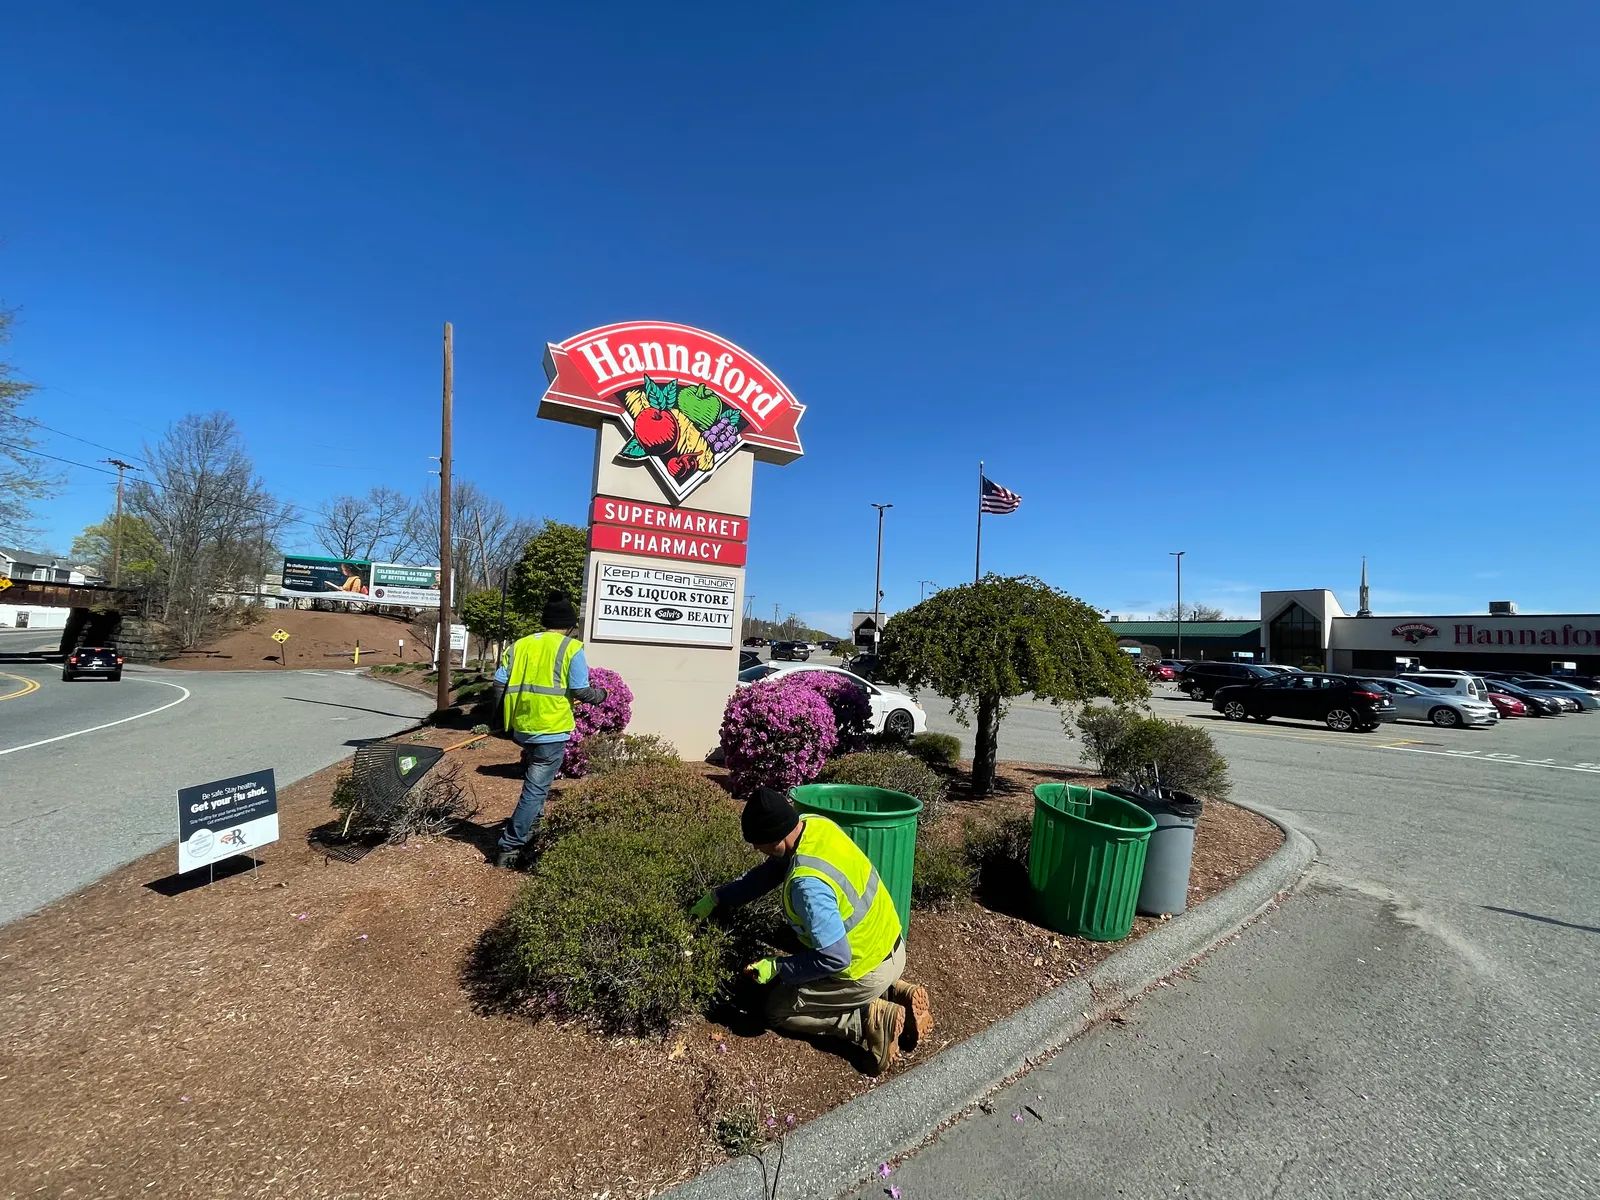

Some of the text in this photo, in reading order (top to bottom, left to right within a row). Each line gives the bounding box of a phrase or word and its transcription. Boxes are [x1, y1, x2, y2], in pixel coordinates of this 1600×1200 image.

[577, 338, 786, 420] Hannaford
[605, 503, 740, 537] SUPERMARKET
[621, 532, 722, 559] PHARMACY
[377, 568, 409, 576] CELEBRATING
[603, 566, 734, 588] Keep it Clean LAUNDRY
[607, 584, 729, 605] T&S LIQUOR STORE
[604, 605, 729, 624] BARBER Salvi's BEAUTY
[1395, 625, 1435, 633] Hannaford
[1454, 624, 1600, 646] Hannafo
[190, 786, 267, 813] Get your flu shot.
[225, 787, 237, 795] Stay
